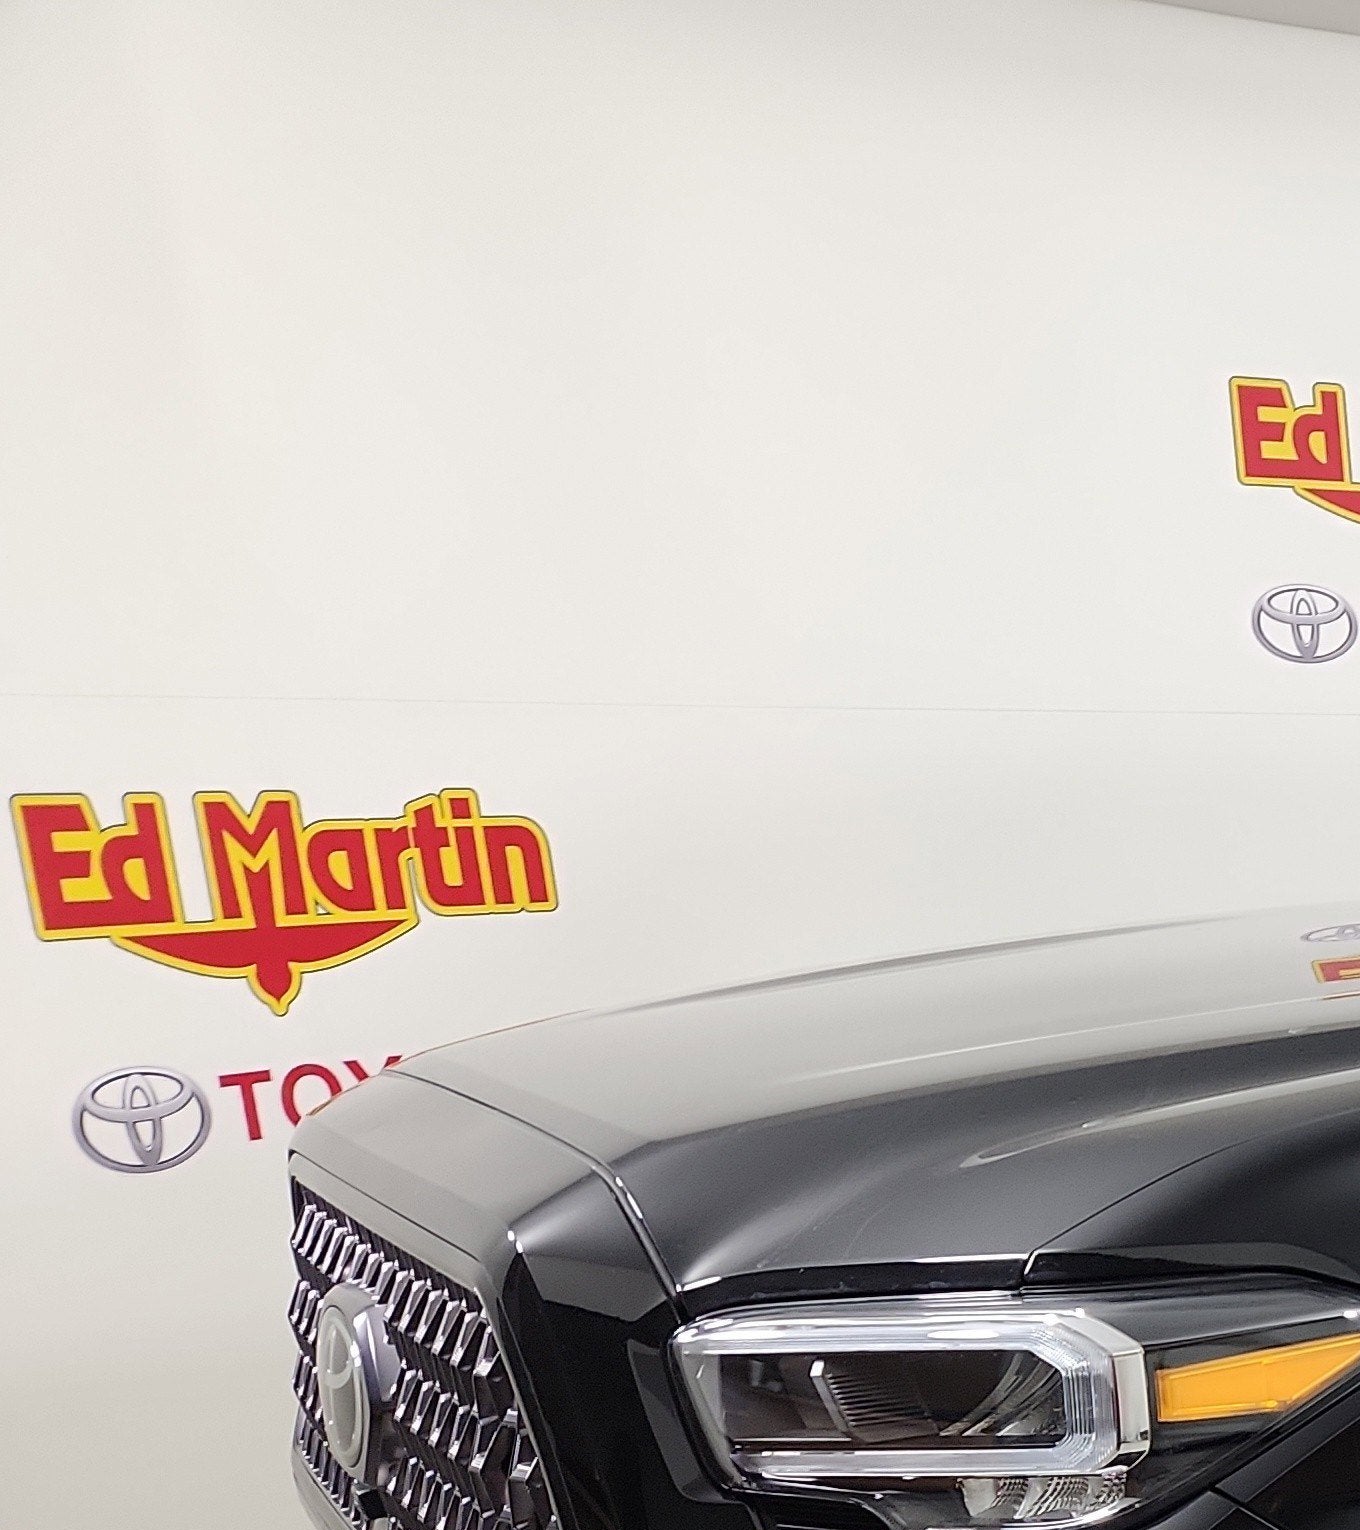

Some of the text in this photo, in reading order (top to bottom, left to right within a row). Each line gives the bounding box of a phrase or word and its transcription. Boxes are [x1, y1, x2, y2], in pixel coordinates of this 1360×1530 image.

[1229, 376, 1350, 487] Ed
[12, 788, 558, 941] Ed Martin
